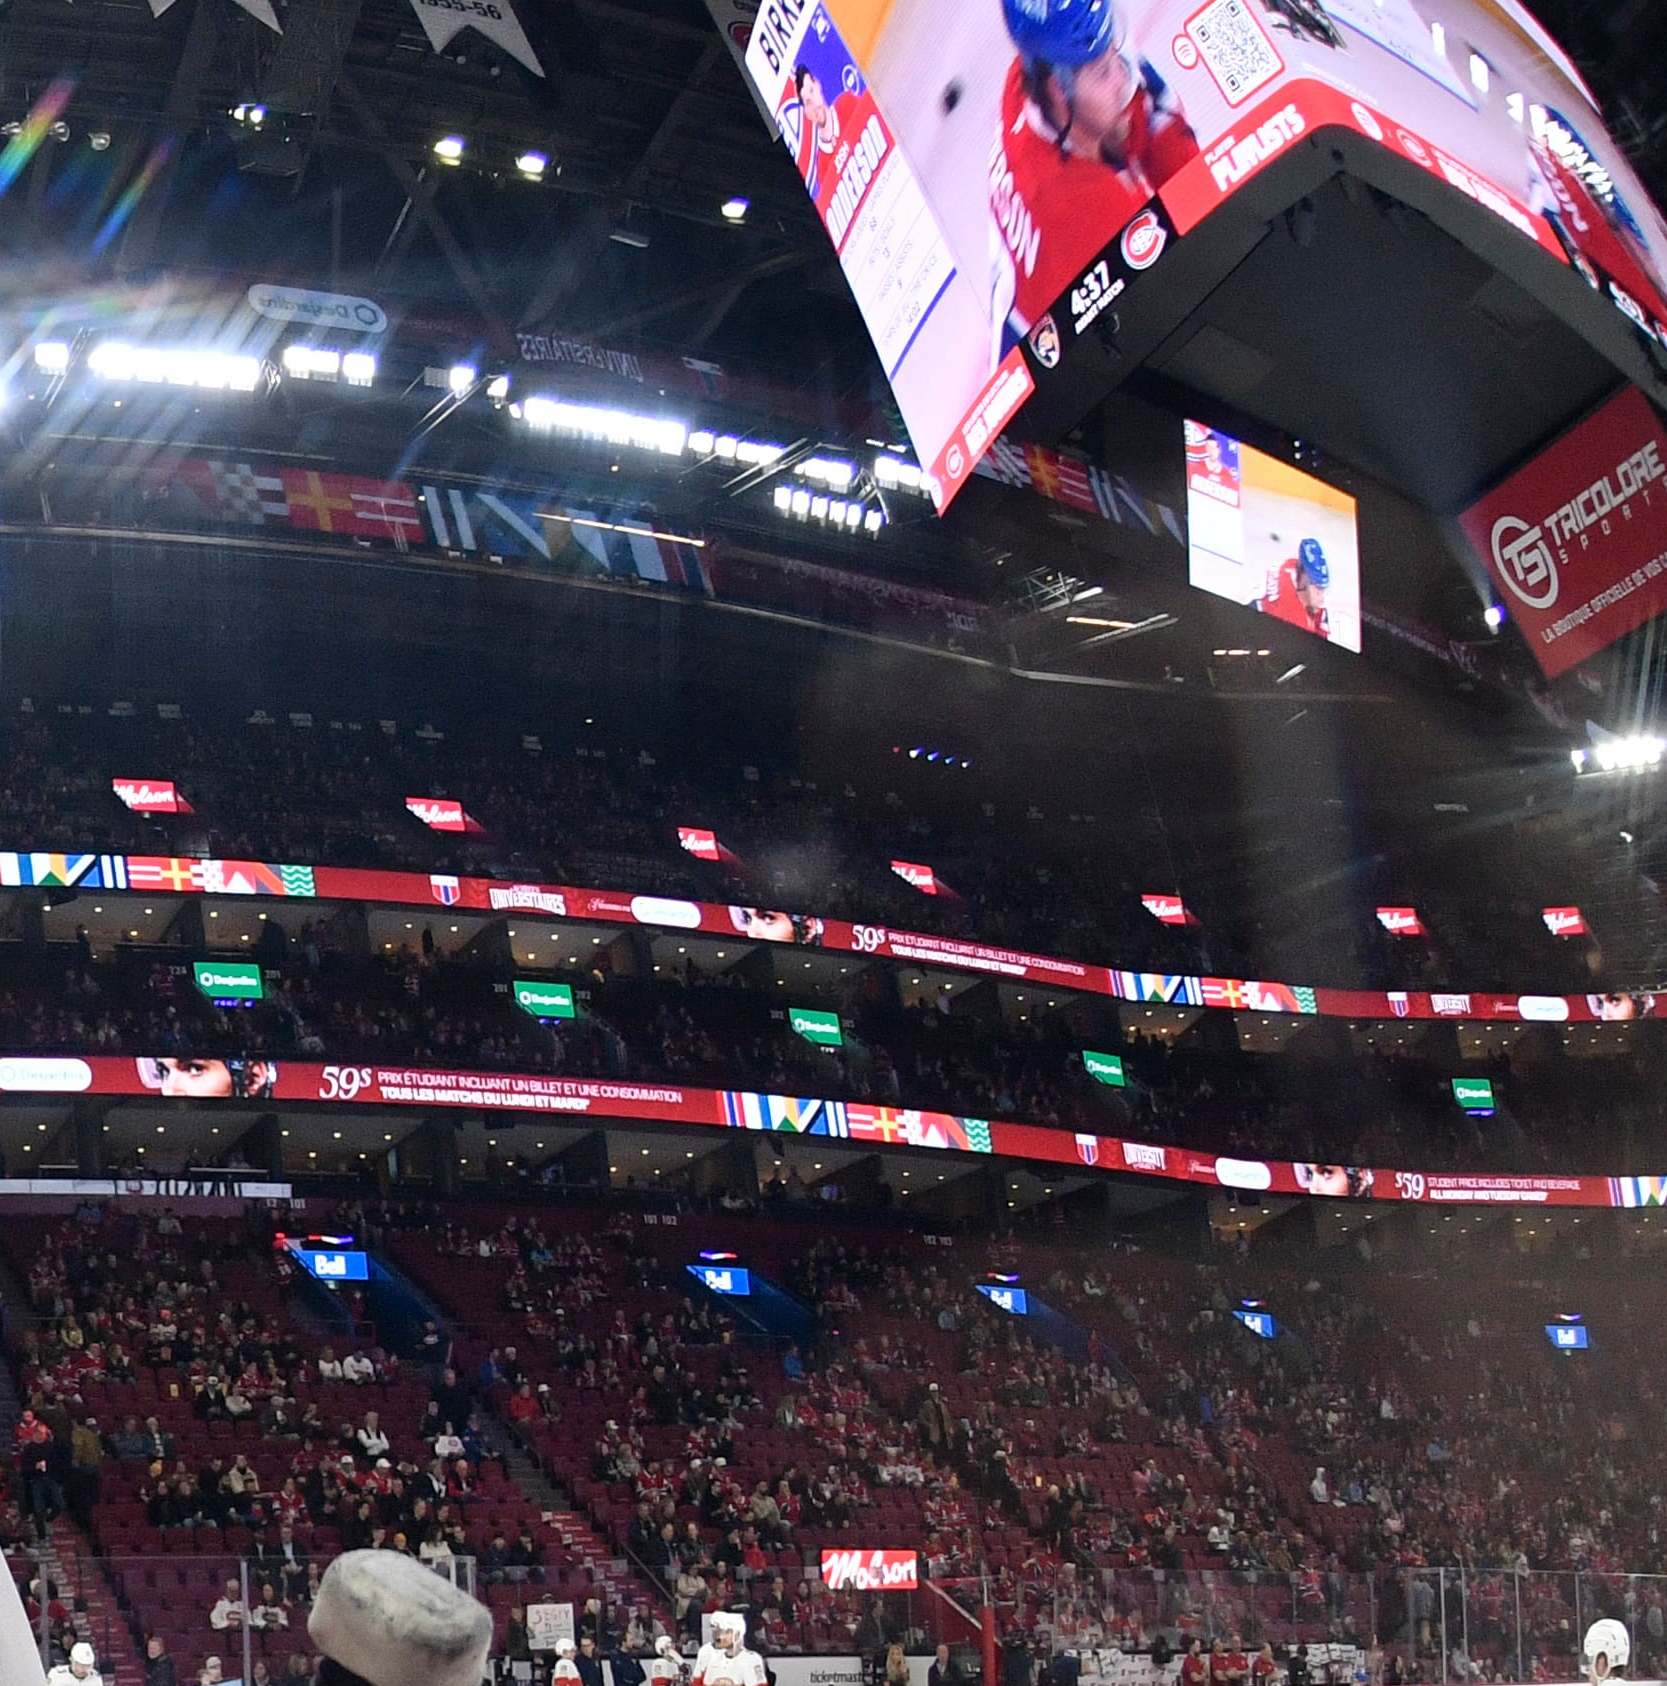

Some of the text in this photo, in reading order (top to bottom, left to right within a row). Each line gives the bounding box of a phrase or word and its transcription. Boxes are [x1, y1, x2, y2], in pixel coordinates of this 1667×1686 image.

[1210, 103, 1305, 192] PLAYLISTS
[1071, 260, 1109, 315] 4:37
[1544, 440, 1665, 546] TRICOLORE
[1541, 628, 1555, 643] LA
[1552, 604, 1593, 638] BOUTIQUE
[1632, 569, 1646, 587] DE
[377, 1071, 403, 1085] PRIX
[514, 1078, 531, 1092] UN
[530, 1079, 563, 1095] BILLET
[563, 1081, 578, 1095] ET
[578, 1082, 601, 1097] UNE
[600, 1085, 683, 1104] CONSOMMATION
[380, 1086, 413, 1100] TOUS
[312, 1254, 344, 1275] Bell
[821, 1551, 917, 1590] Molson
